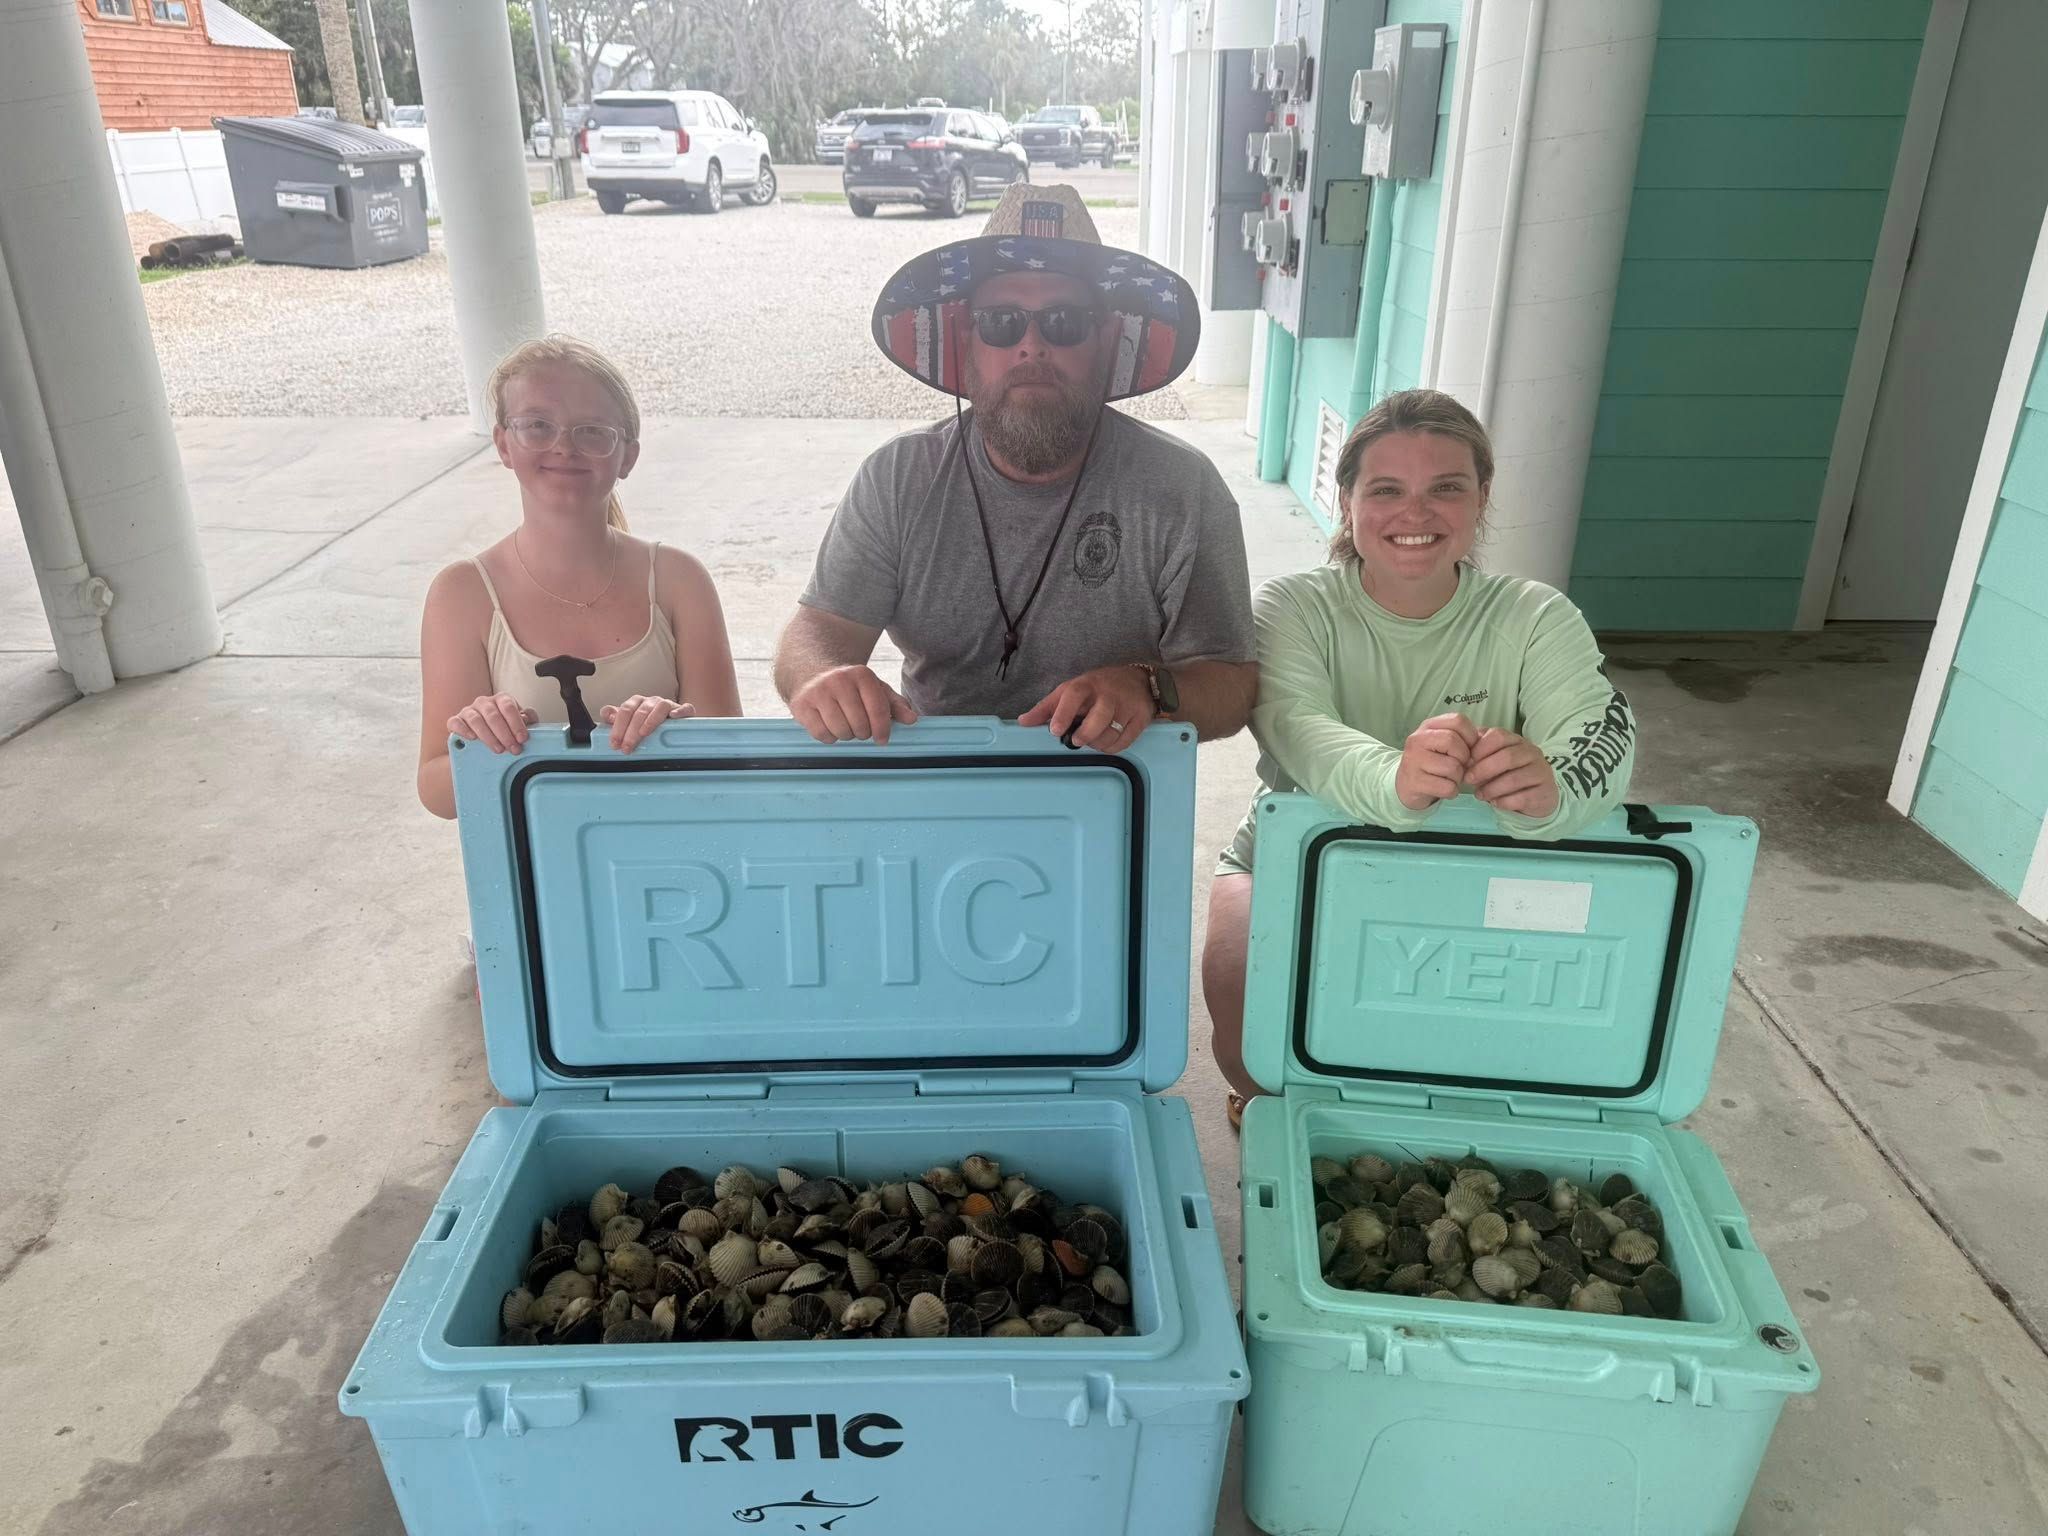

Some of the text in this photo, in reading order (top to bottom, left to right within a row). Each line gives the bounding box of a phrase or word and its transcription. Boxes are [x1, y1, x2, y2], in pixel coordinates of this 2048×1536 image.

[607, 856, 1054, 992] RTIC
[1373, 934, 1613, 1010] YETI
[674, 1413, 904, 1463] RTIC
